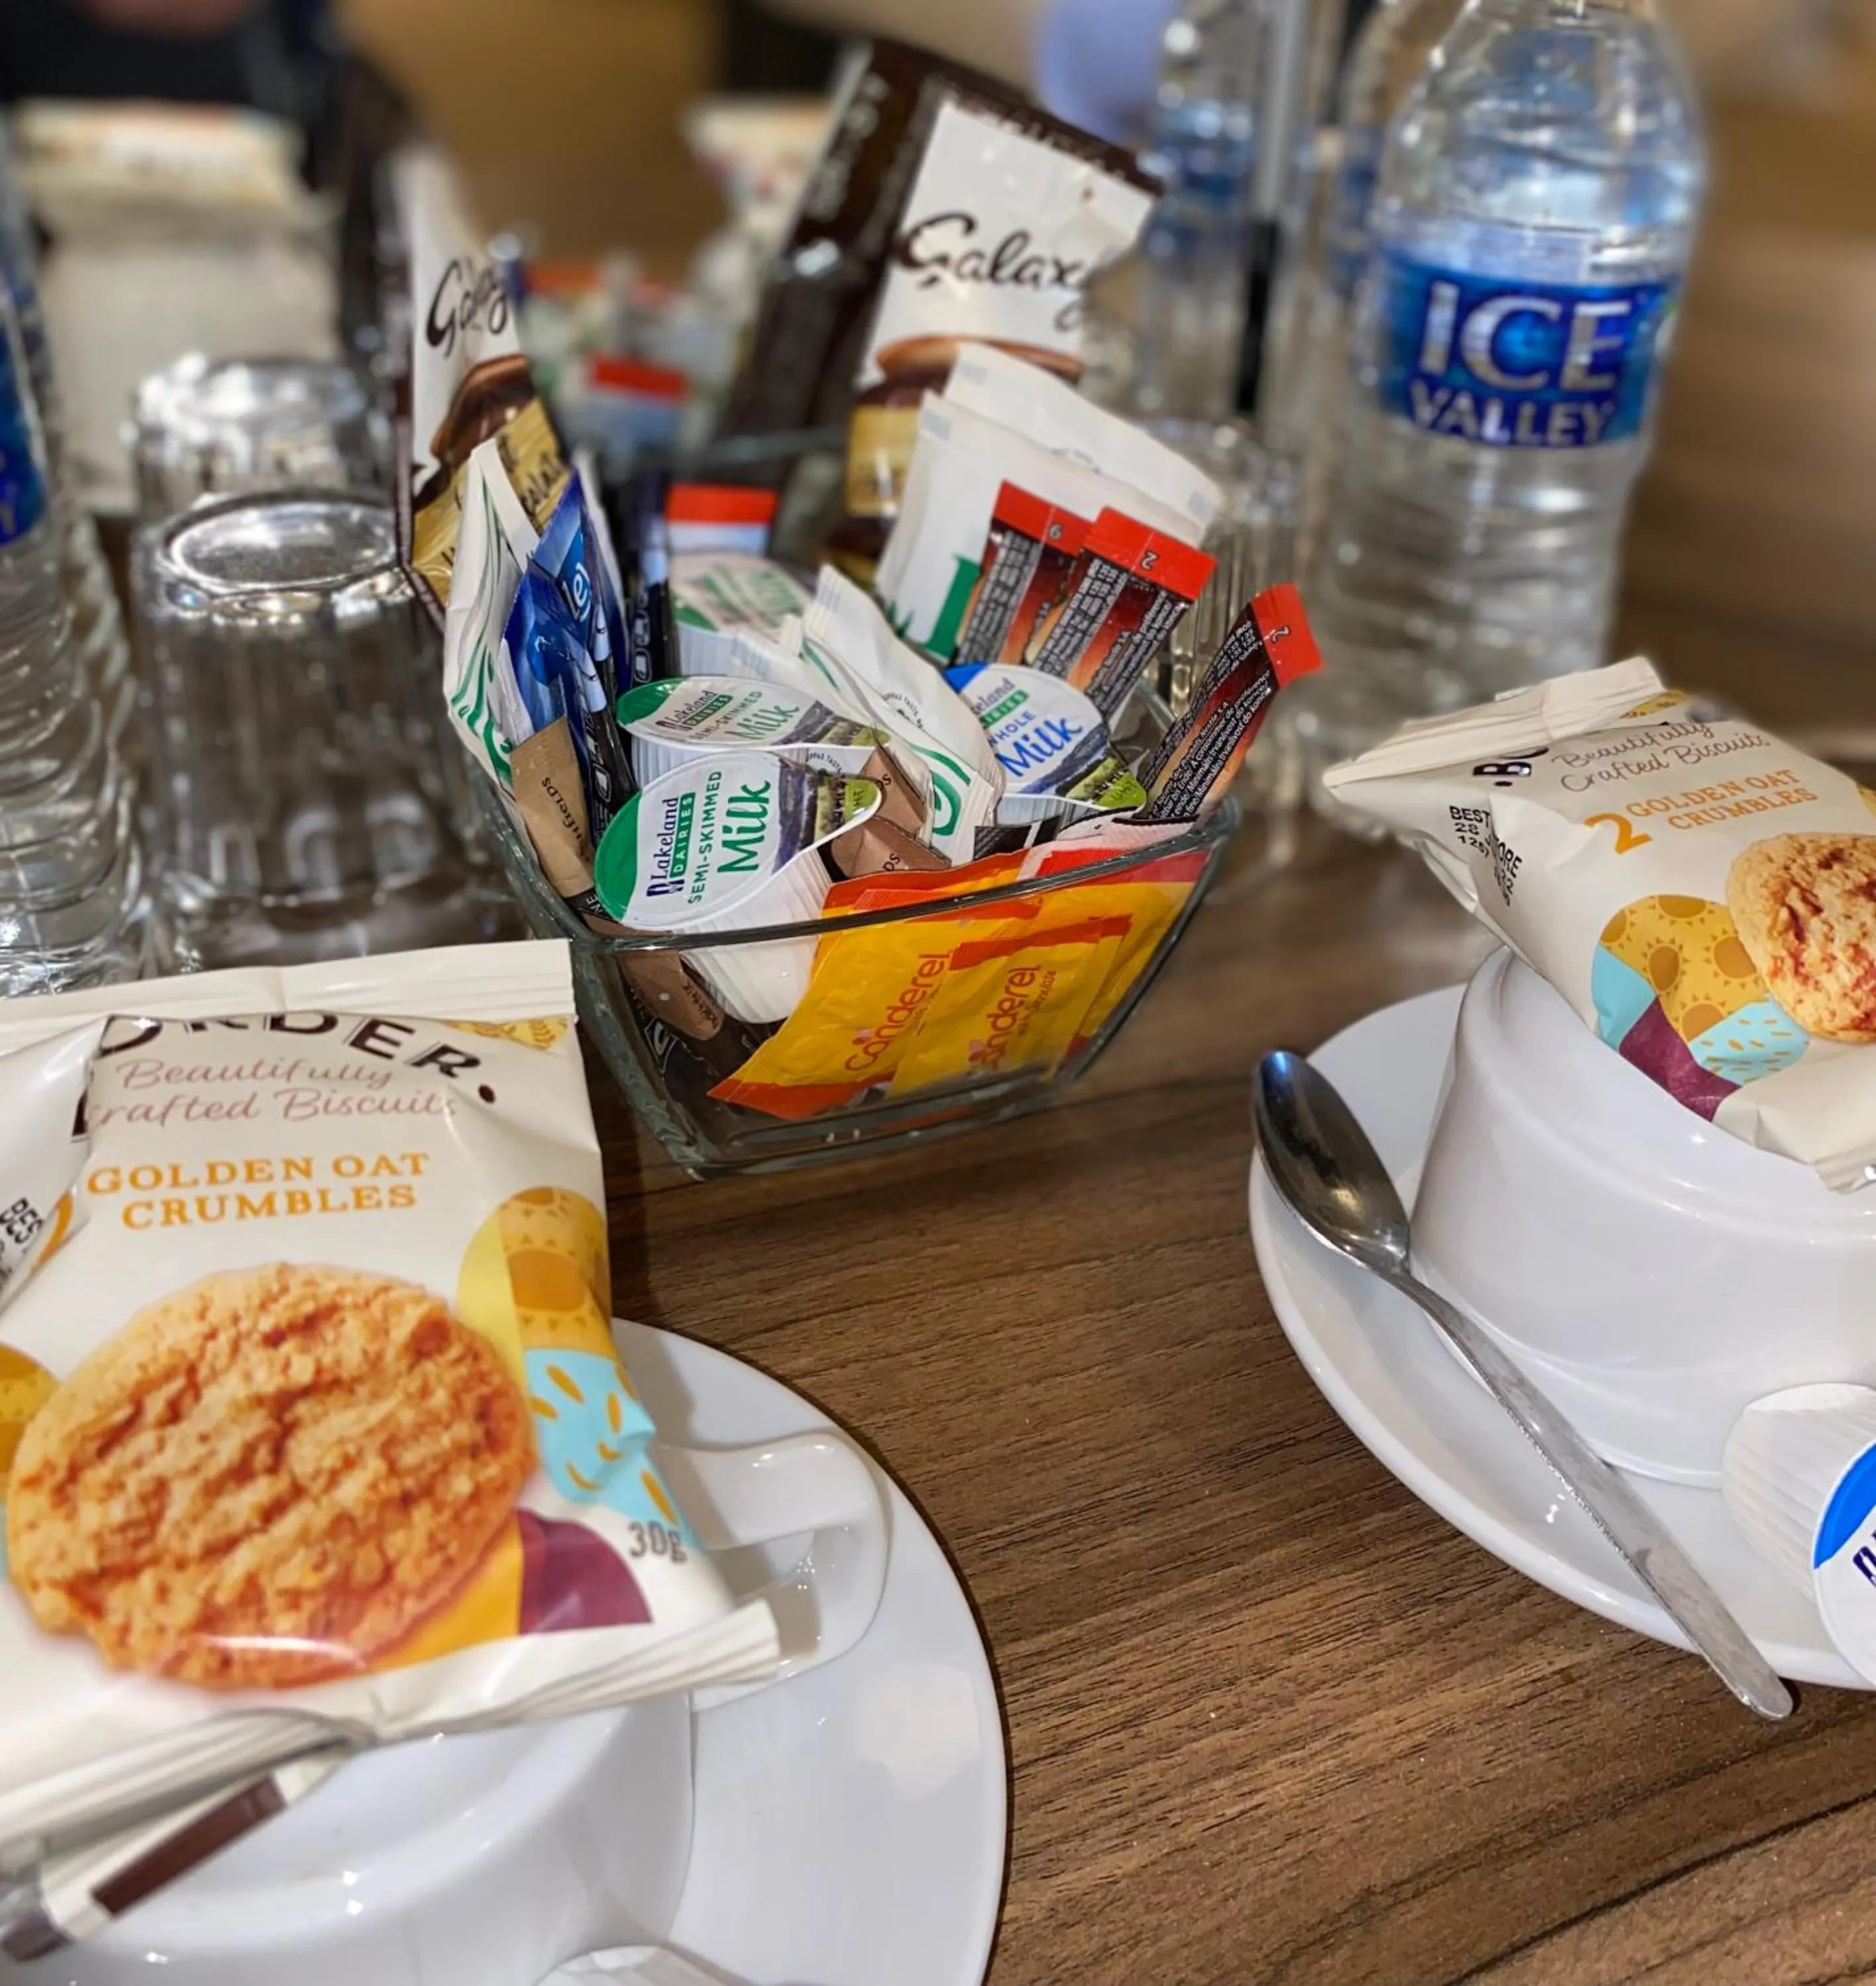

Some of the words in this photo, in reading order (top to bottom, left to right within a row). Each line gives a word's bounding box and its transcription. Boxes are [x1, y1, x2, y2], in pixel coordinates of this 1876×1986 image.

[1419, 280, 1630, 391] ICE
[1410, 379, 1613, 446] VALLEY
[970, 677, 1016, 716] eland
[726, 704, 800, 740] Milk
[1552, 718, 1715, 769] Beautifully
[995, 717, 1083, 778] Milk
[1560, 754, 1670, 792] Crafted
[1625, 780, 1743, 819] GOLDEN
[1742, 769, 1803, 795] OAT
[716, 780, 771, 874] Milk
[1449, 805, 1491, 828] BEST
[1667, 786, 1819, 831] CRUMBLES
[653, 796, 679, 880] Lakeland
[673, 798, 694, 876] DAIRIES
[688, 771, 723, 904] SEMI-SKIMMED
[1583, 812, 1653, 855] 2
[845, 954, 951, 1072] Canderel
[967, 965, 1042, 1075] anderel
[116, 1057, 393, 1091] Beautifully
[273, 1086, 458, 1121] Biscuits
[87, 1157, 316, 1196] GOLDEN
[332, 1152, 430, 1178] OAT
[121, 1183, 418, 1231] CRUMBLES
[628, 1520, 689, 1564] 30g
